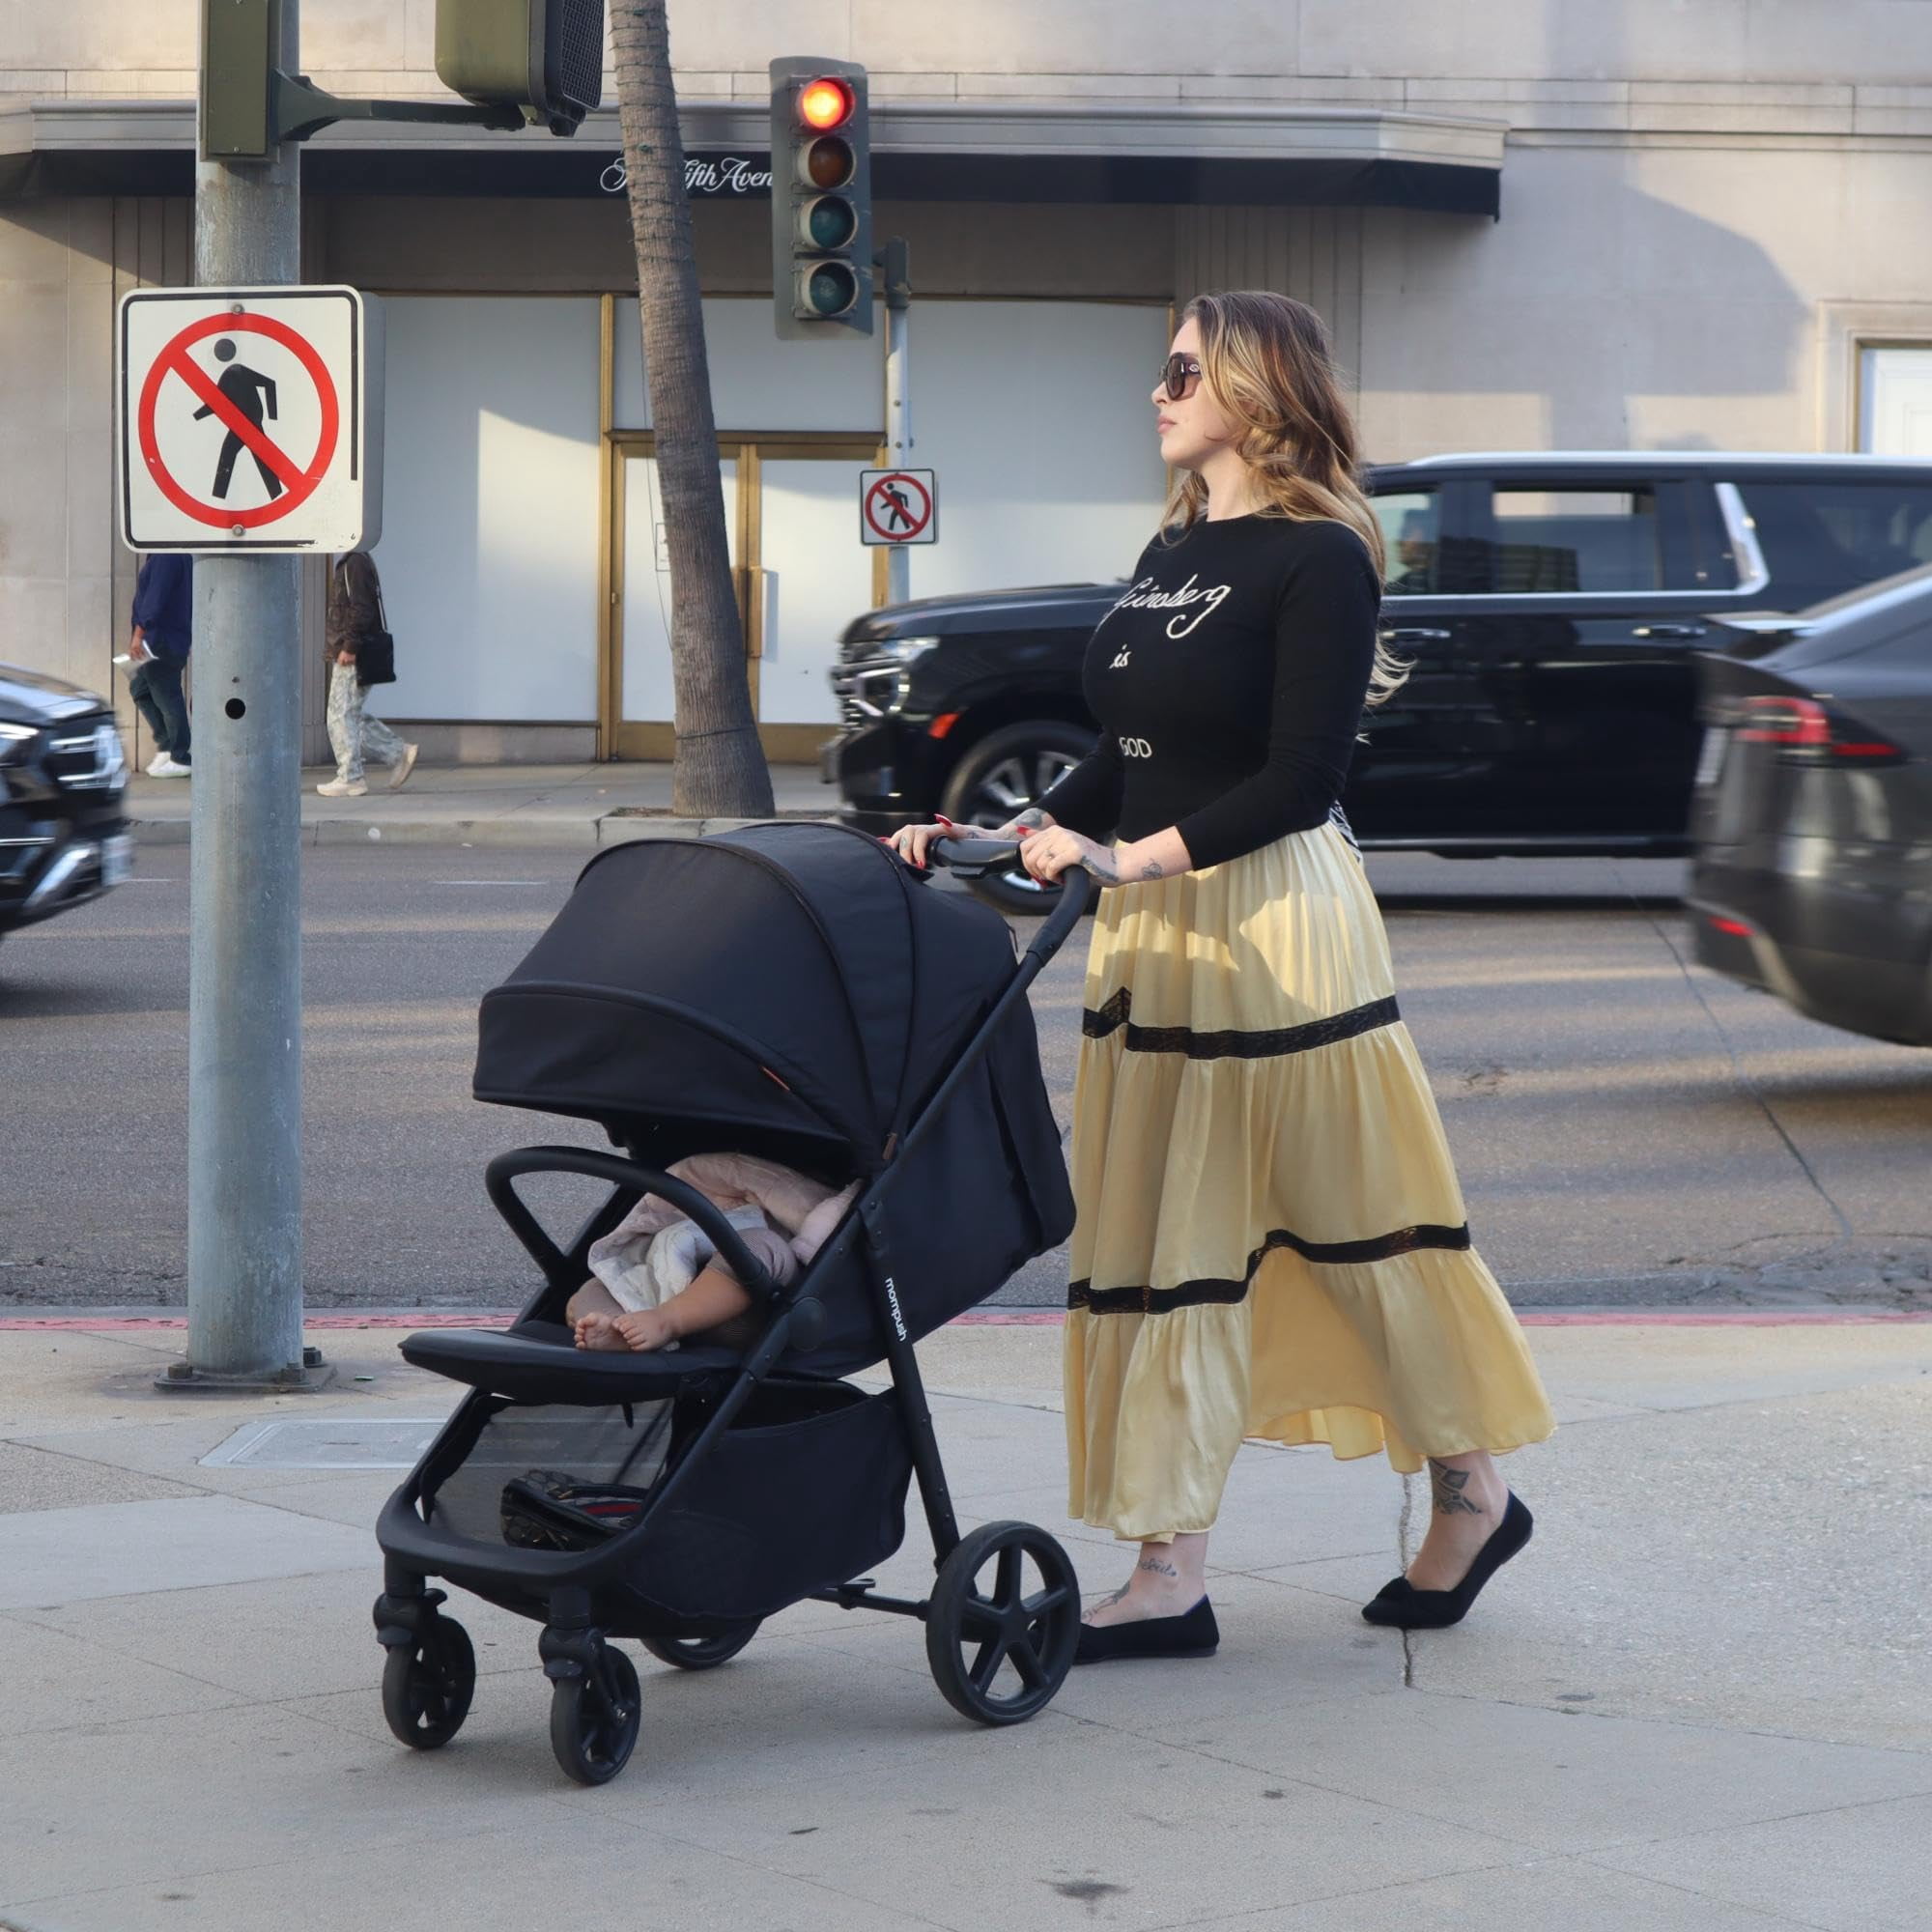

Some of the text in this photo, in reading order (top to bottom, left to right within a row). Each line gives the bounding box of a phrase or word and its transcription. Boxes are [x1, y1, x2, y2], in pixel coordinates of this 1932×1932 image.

[703, 157, 773, 191] Aven
[1110, 644, 1131, 668] is
[1119, 736, 1152, 757] GOD
[885, 1277, 907, 1342] mompush
